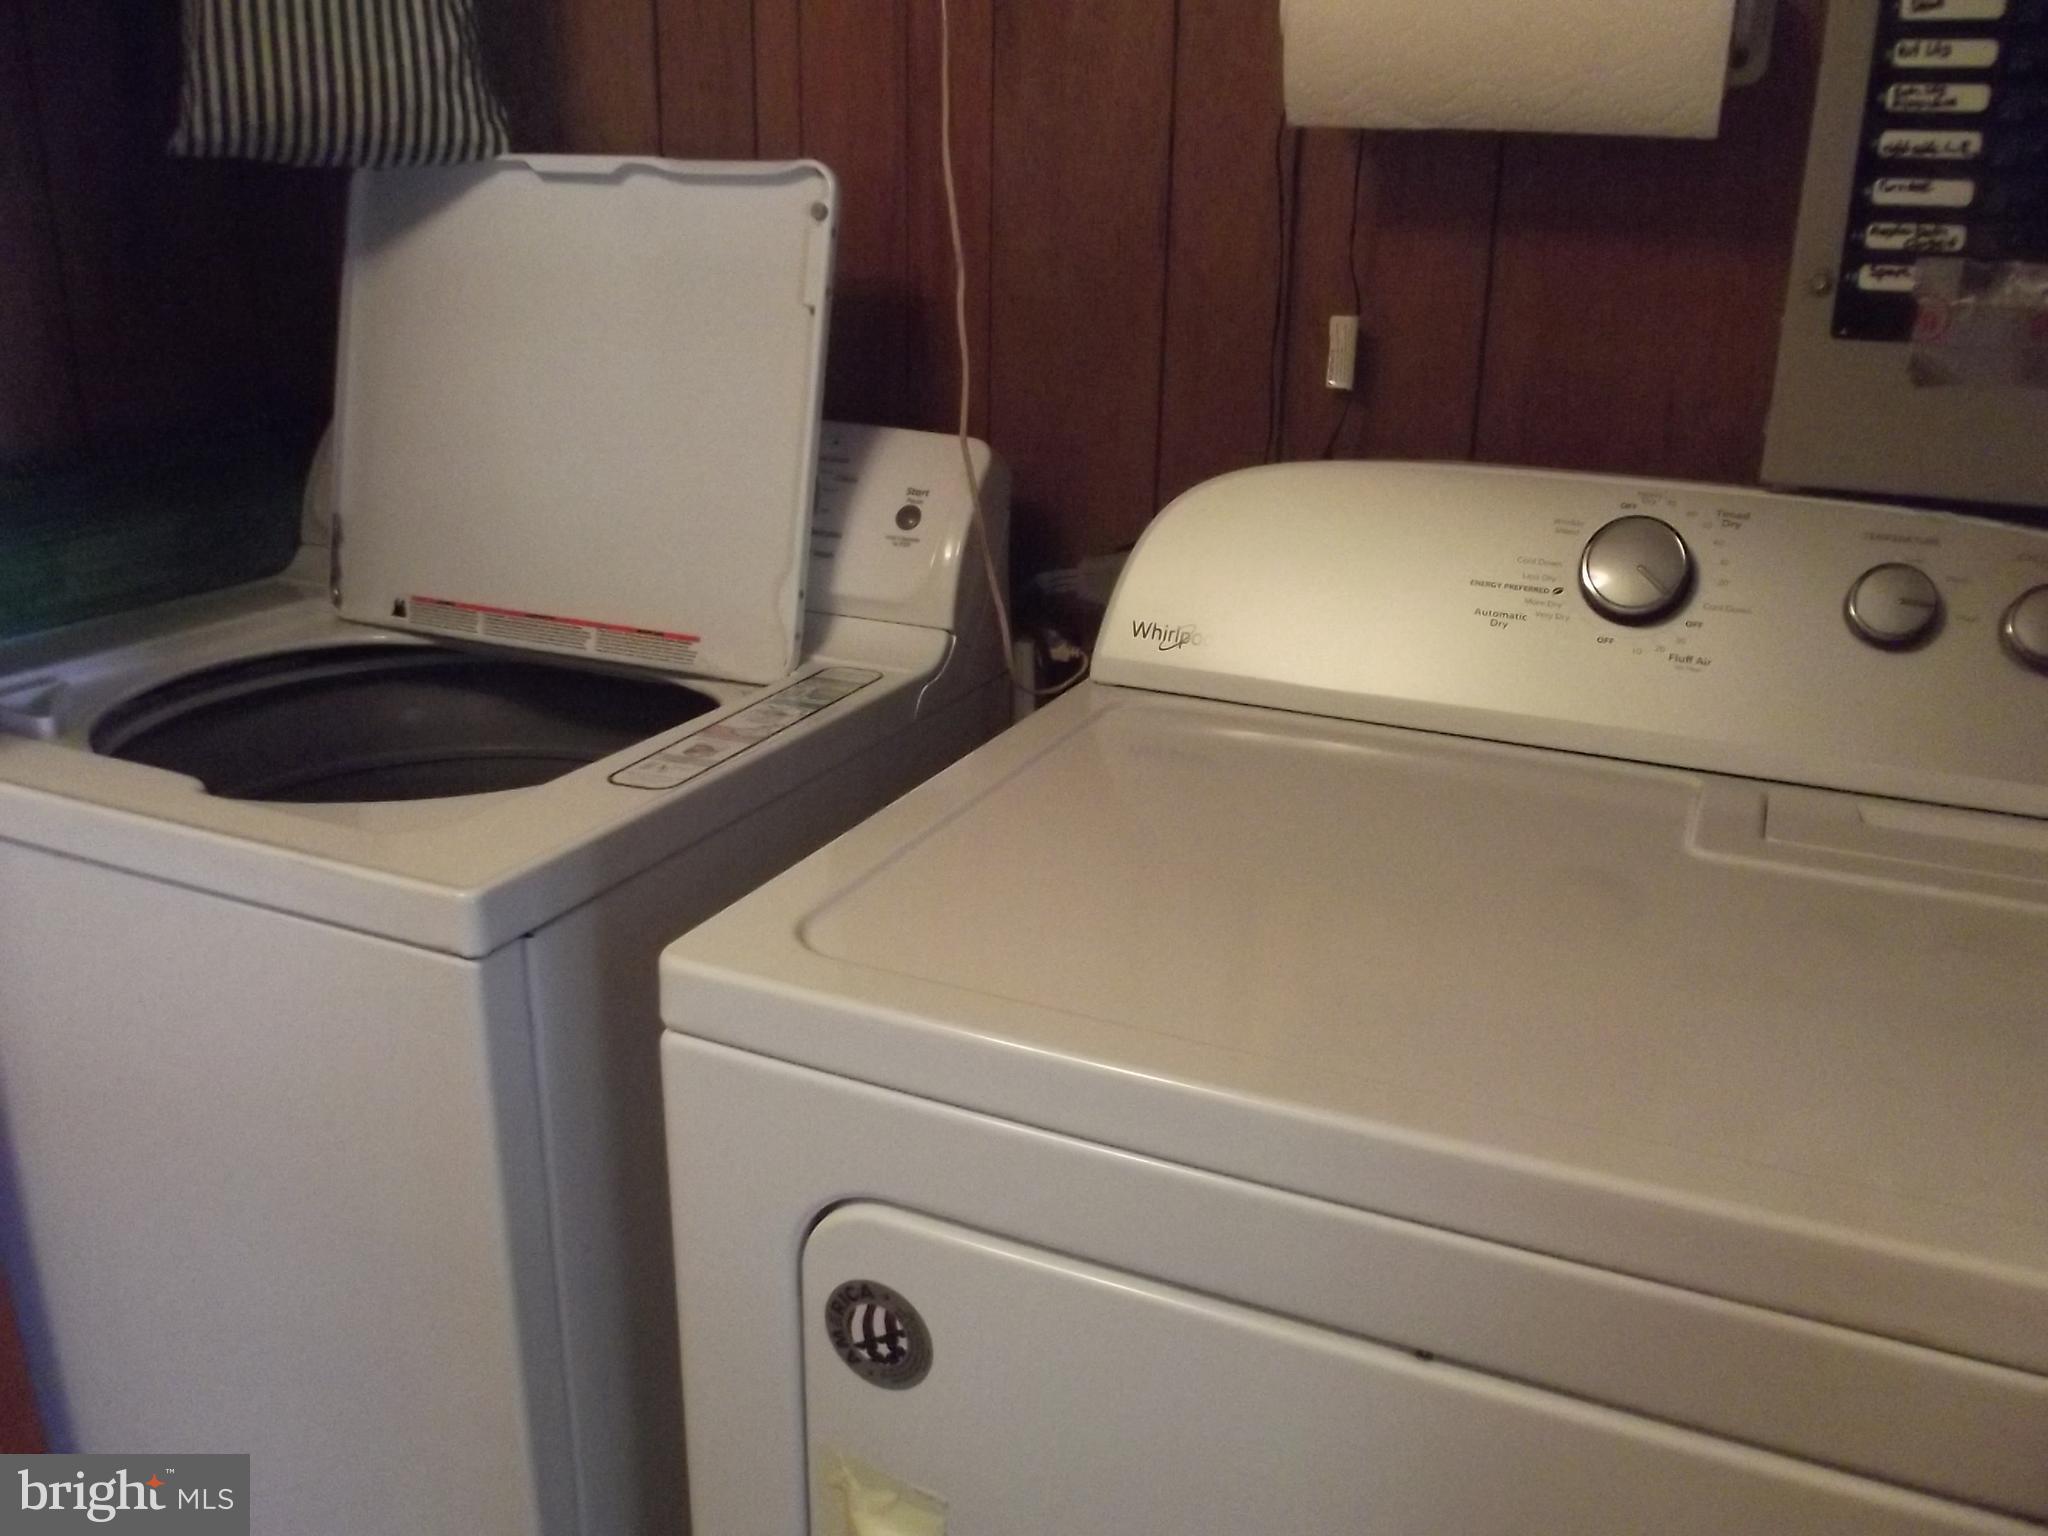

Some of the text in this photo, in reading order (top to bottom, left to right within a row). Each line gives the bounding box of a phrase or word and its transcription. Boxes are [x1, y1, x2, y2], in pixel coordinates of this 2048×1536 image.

[1470, 579, 1550, 594] ENERGY PREFERRED
[1474, 607, 1528, 622] Automatic
[1489, 618, 1509, 630] Dry
[1132, 619, 1205, 651] Whirlpo
[1596, 636, 1614, 644] OFF
[1668, 653, 1712, 666] Fluff Air
